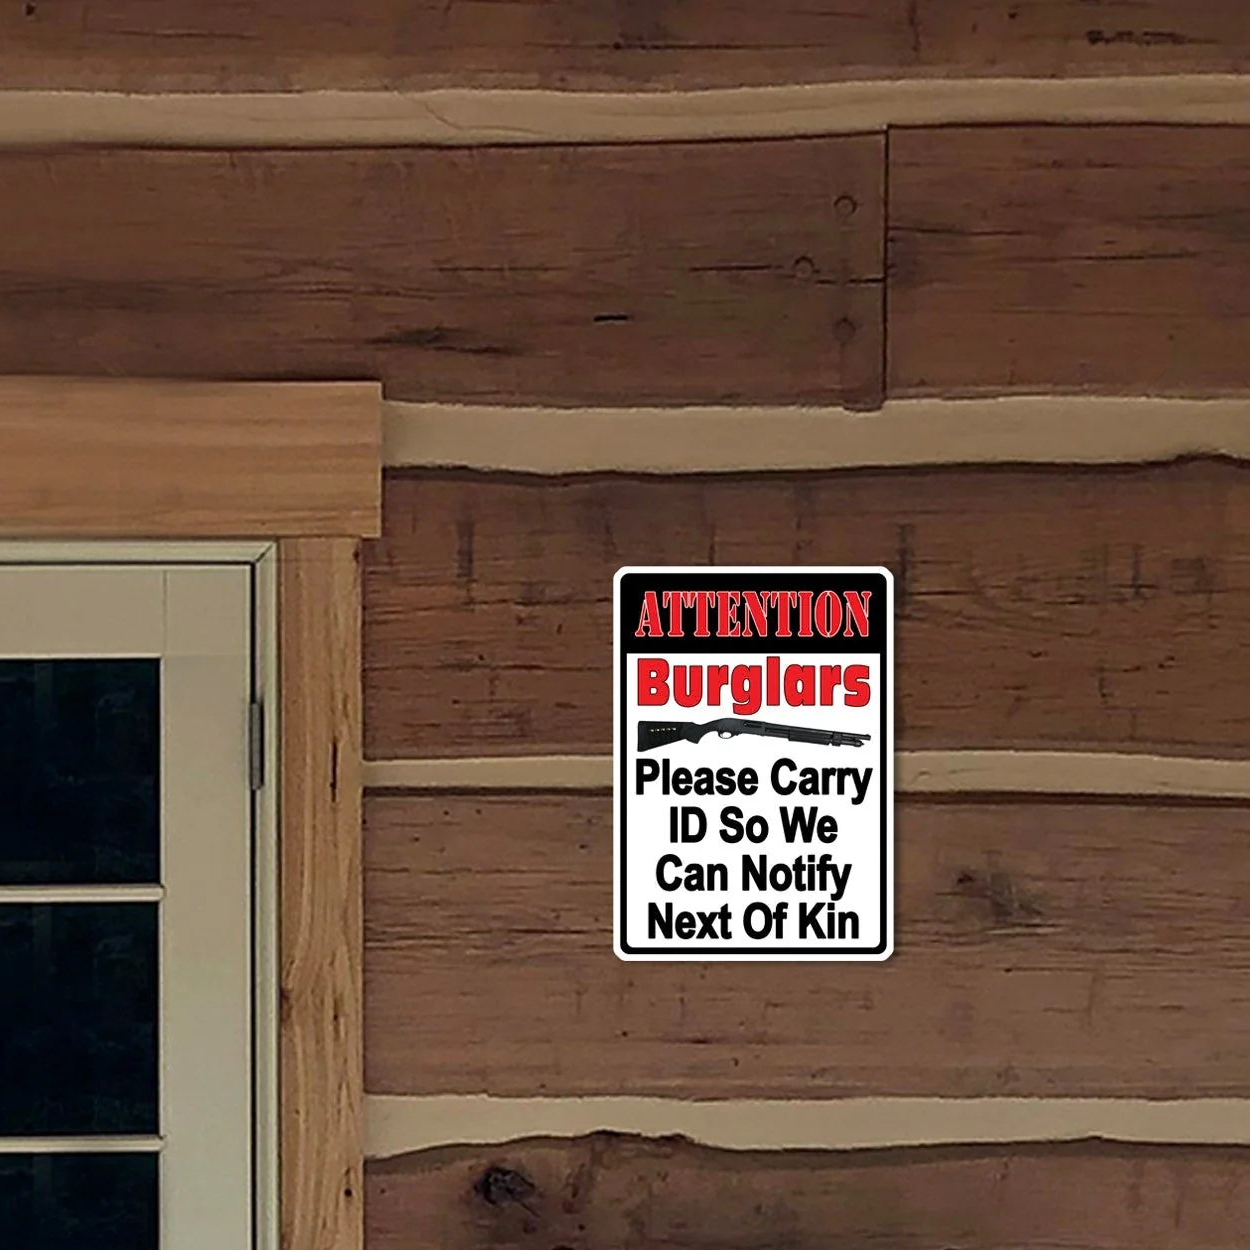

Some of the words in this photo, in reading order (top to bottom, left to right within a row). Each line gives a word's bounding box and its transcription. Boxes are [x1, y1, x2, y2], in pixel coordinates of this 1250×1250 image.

[635, 591, 872, 638] ATTENTION
[637, 656, 872, 716] Burglars
[635, 758, 759, 796] Please
[770, 758, 873, 805] Carry
[669, 806, 708, 844] ID
[719, 806, 769, 844] So
[780, 806, 838, 844] We
[655, 853, 729, 892] Can
[742, 853, 852, 900] Notify
[647, 902, 732, 940] Next
[743, 902, 789, 940] Of
[799, 902, 860, 940] Kin
